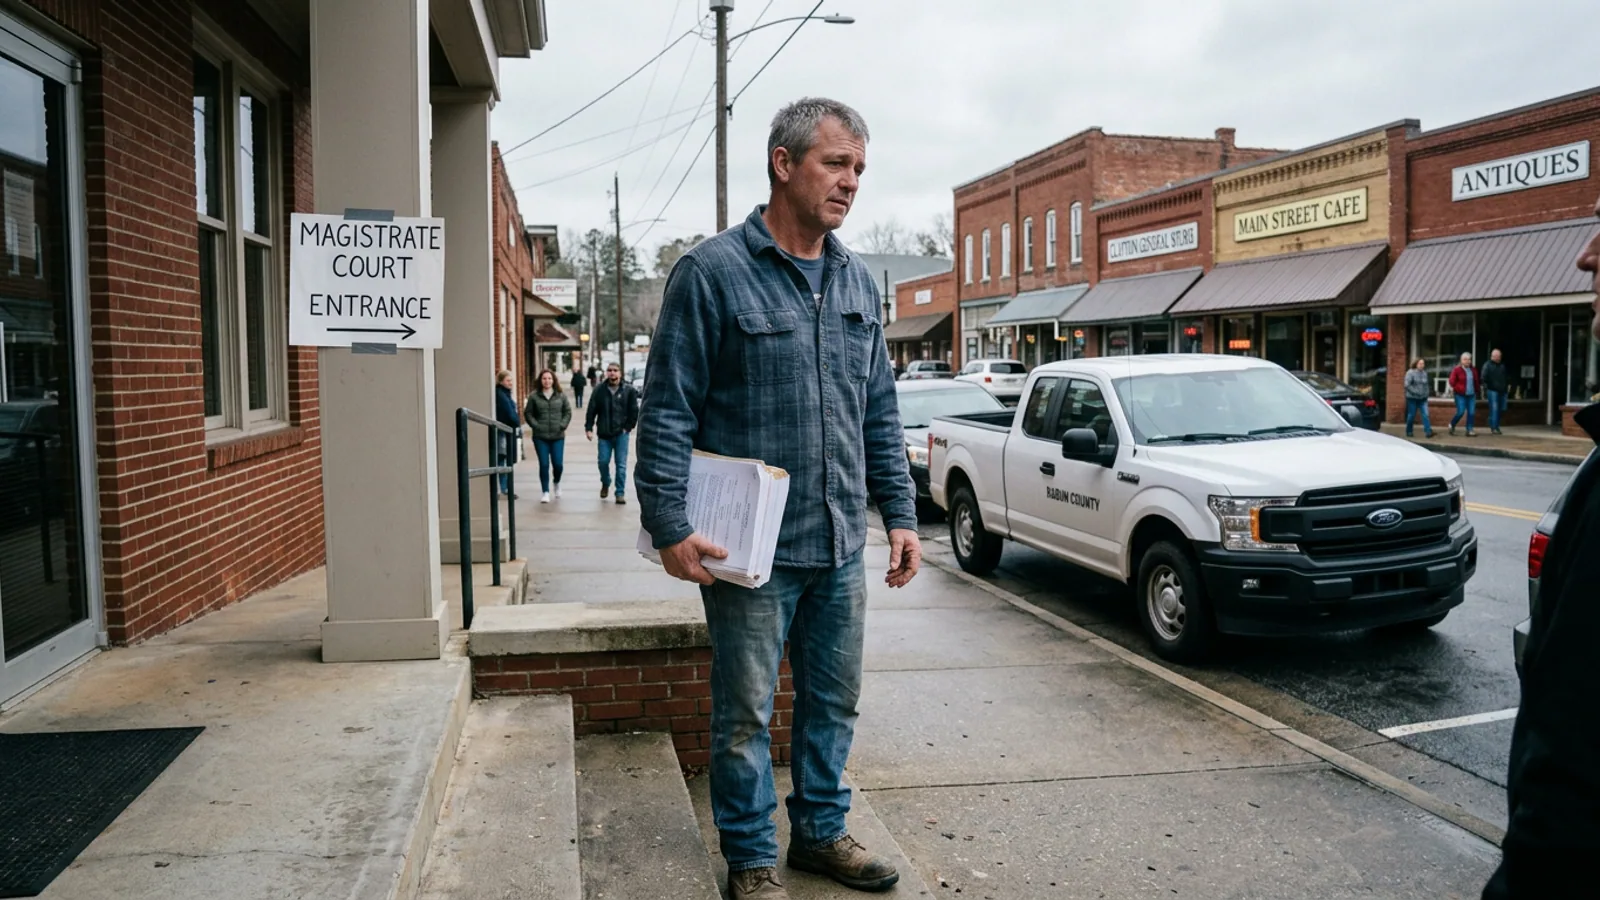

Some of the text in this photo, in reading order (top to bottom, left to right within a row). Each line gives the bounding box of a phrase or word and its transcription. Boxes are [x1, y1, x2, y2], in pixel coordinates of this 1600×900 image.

[1459, 149, 1580, 194] ANTIQUES
[1238, 195, 1361, 235] MAIN STREET CAFE
[300, 221, 441, 250] MAGISTRATE
[332, 254, 413, 279] COURT
[309, 293, 432, 319] ENTRANCE
[1070, 492, 1101, 512] COUNTY
